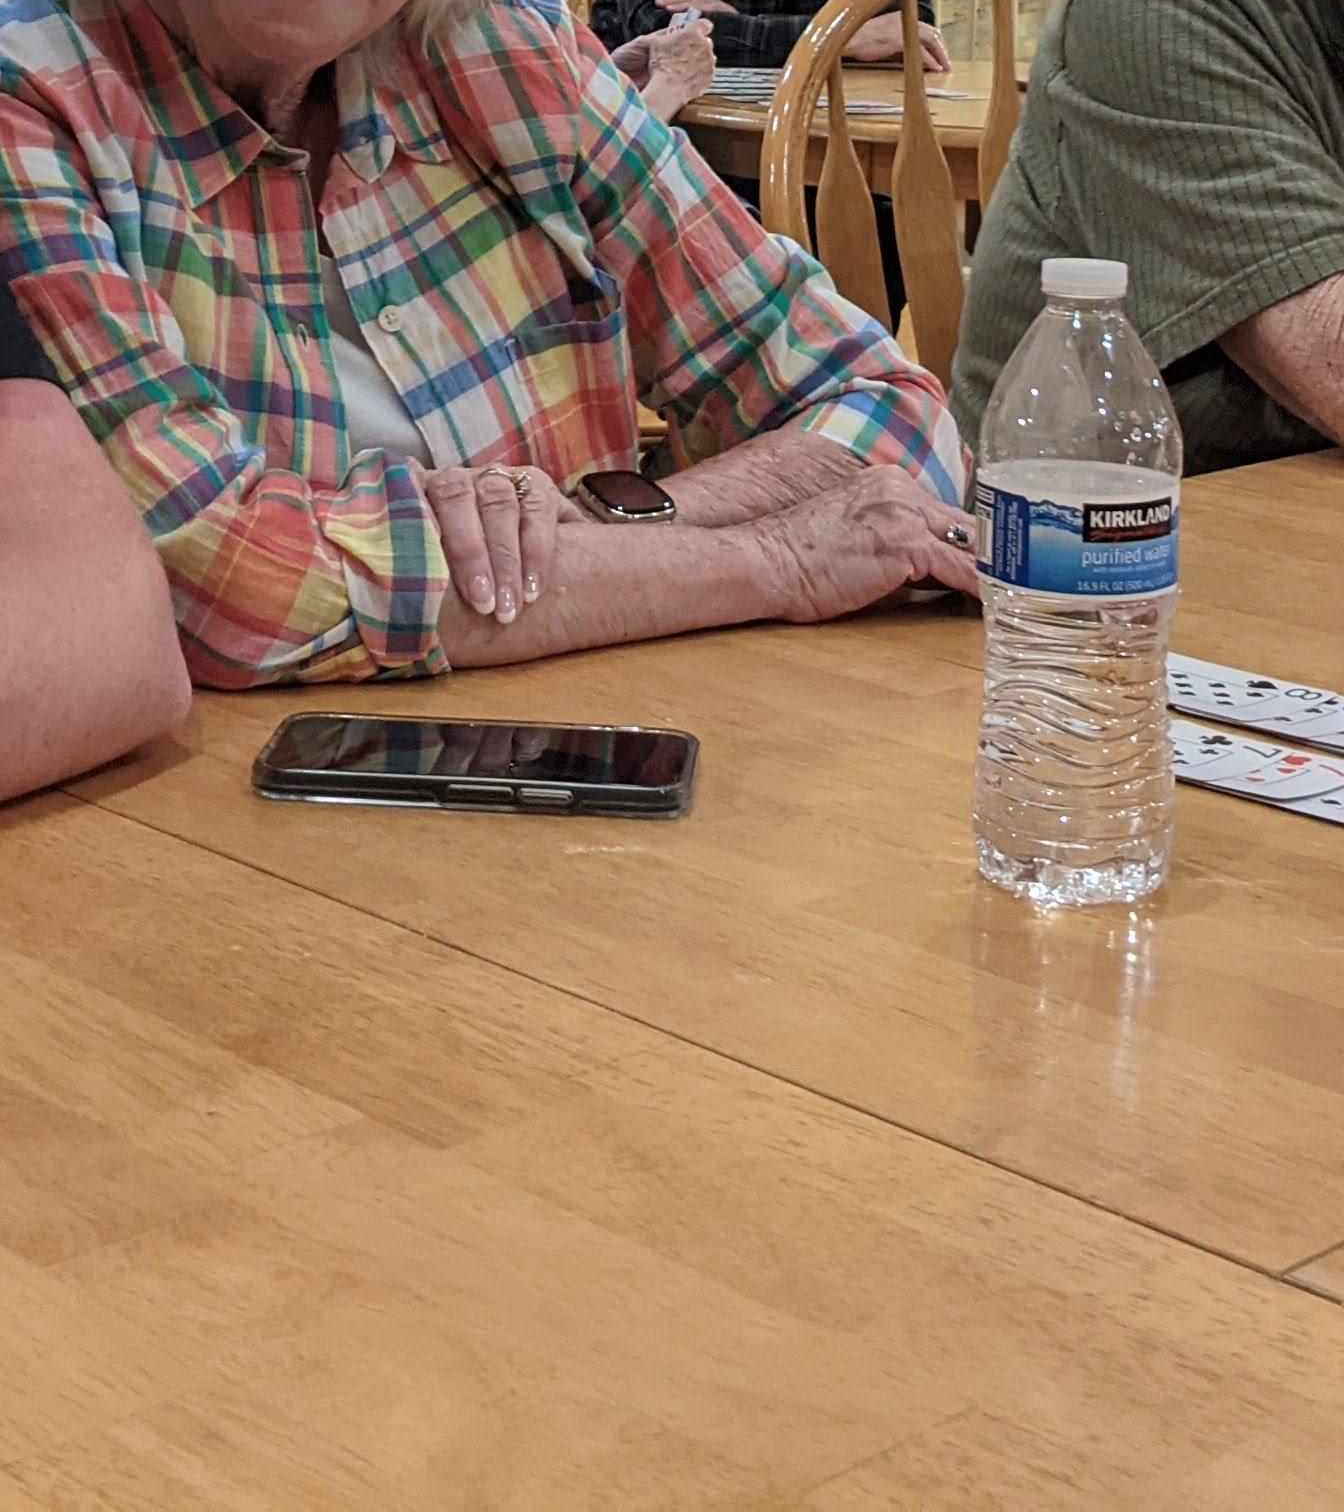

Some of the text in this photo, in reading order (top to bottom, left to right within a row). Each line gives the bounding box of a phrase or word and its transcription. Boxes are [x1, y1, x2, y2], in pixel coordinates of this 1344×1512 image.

[1089, 504, 1171, 528] KIRKLAND
[1082, 547, 1142, 568] purified
[1285, 688, 1322, 700] 8
[1243, 745, 1283, 758] 7
